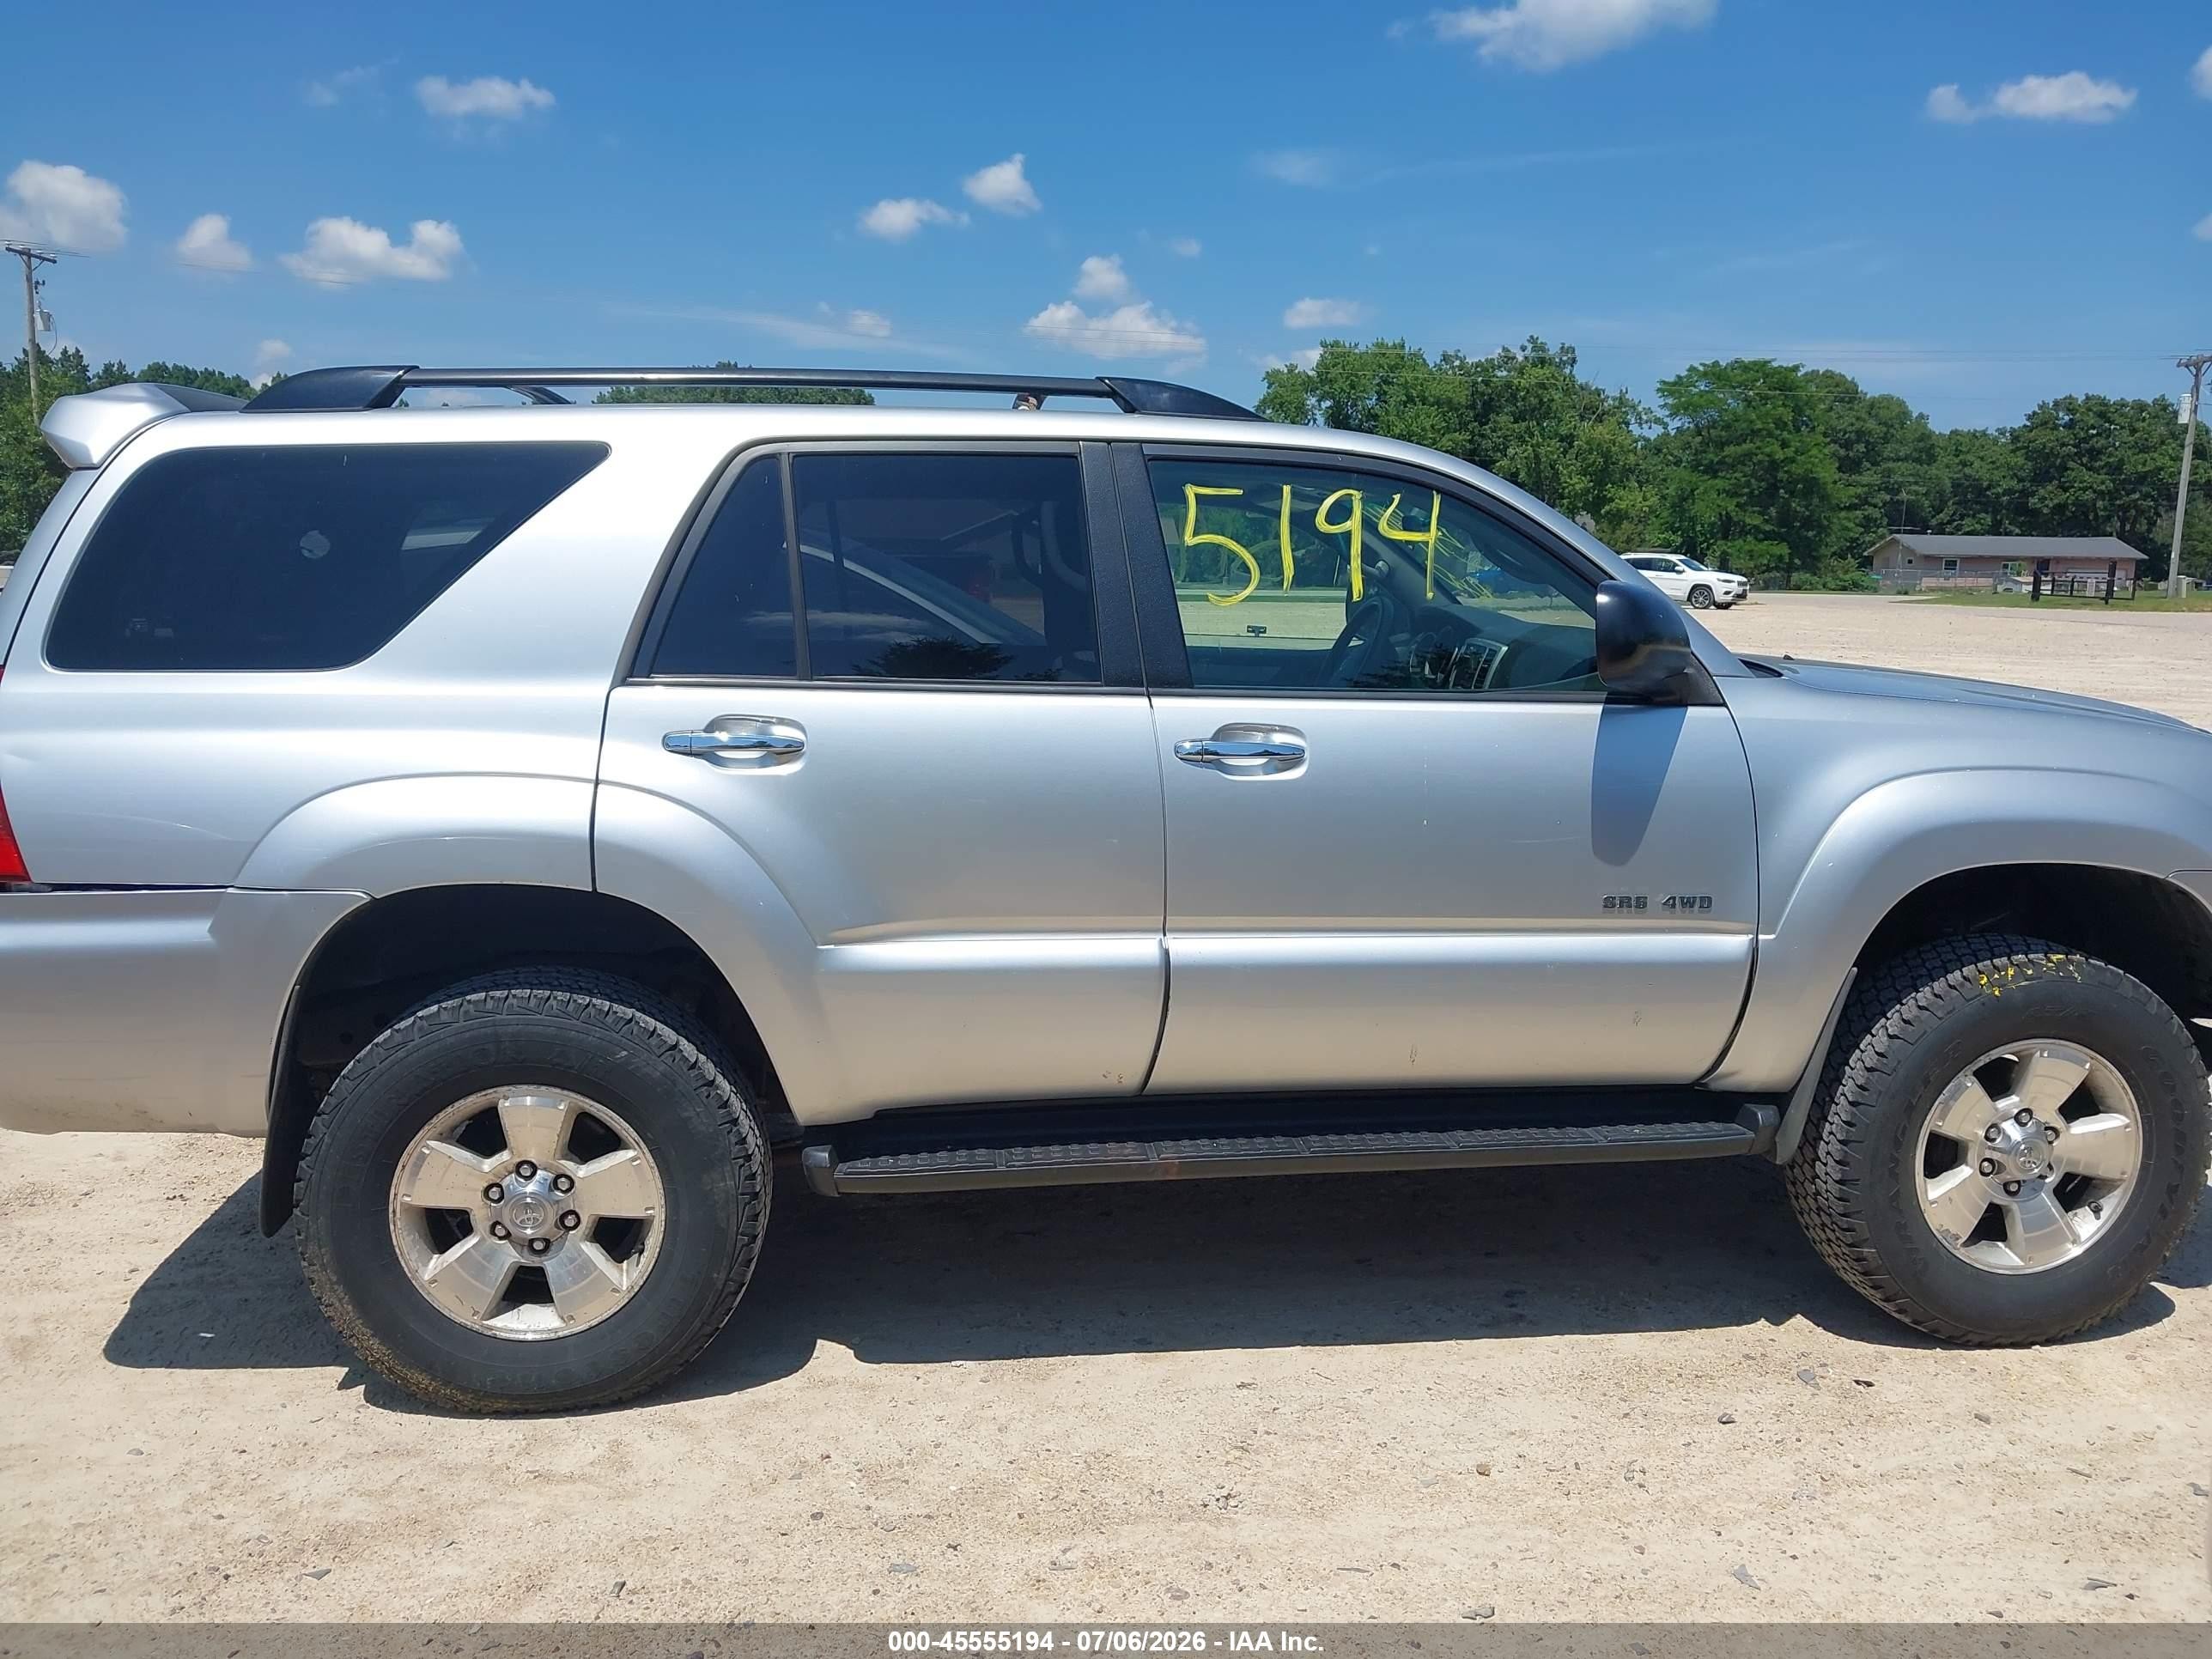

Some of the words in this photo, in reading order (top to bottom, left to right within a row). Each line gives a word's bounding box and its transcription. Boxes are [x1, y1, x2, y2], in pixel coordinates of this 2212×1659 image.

[1183, 483, 1442, 606] 5194
[1602, 895, 1649, 908] SR5
[1661, 895, 1713, 908] 4WD
